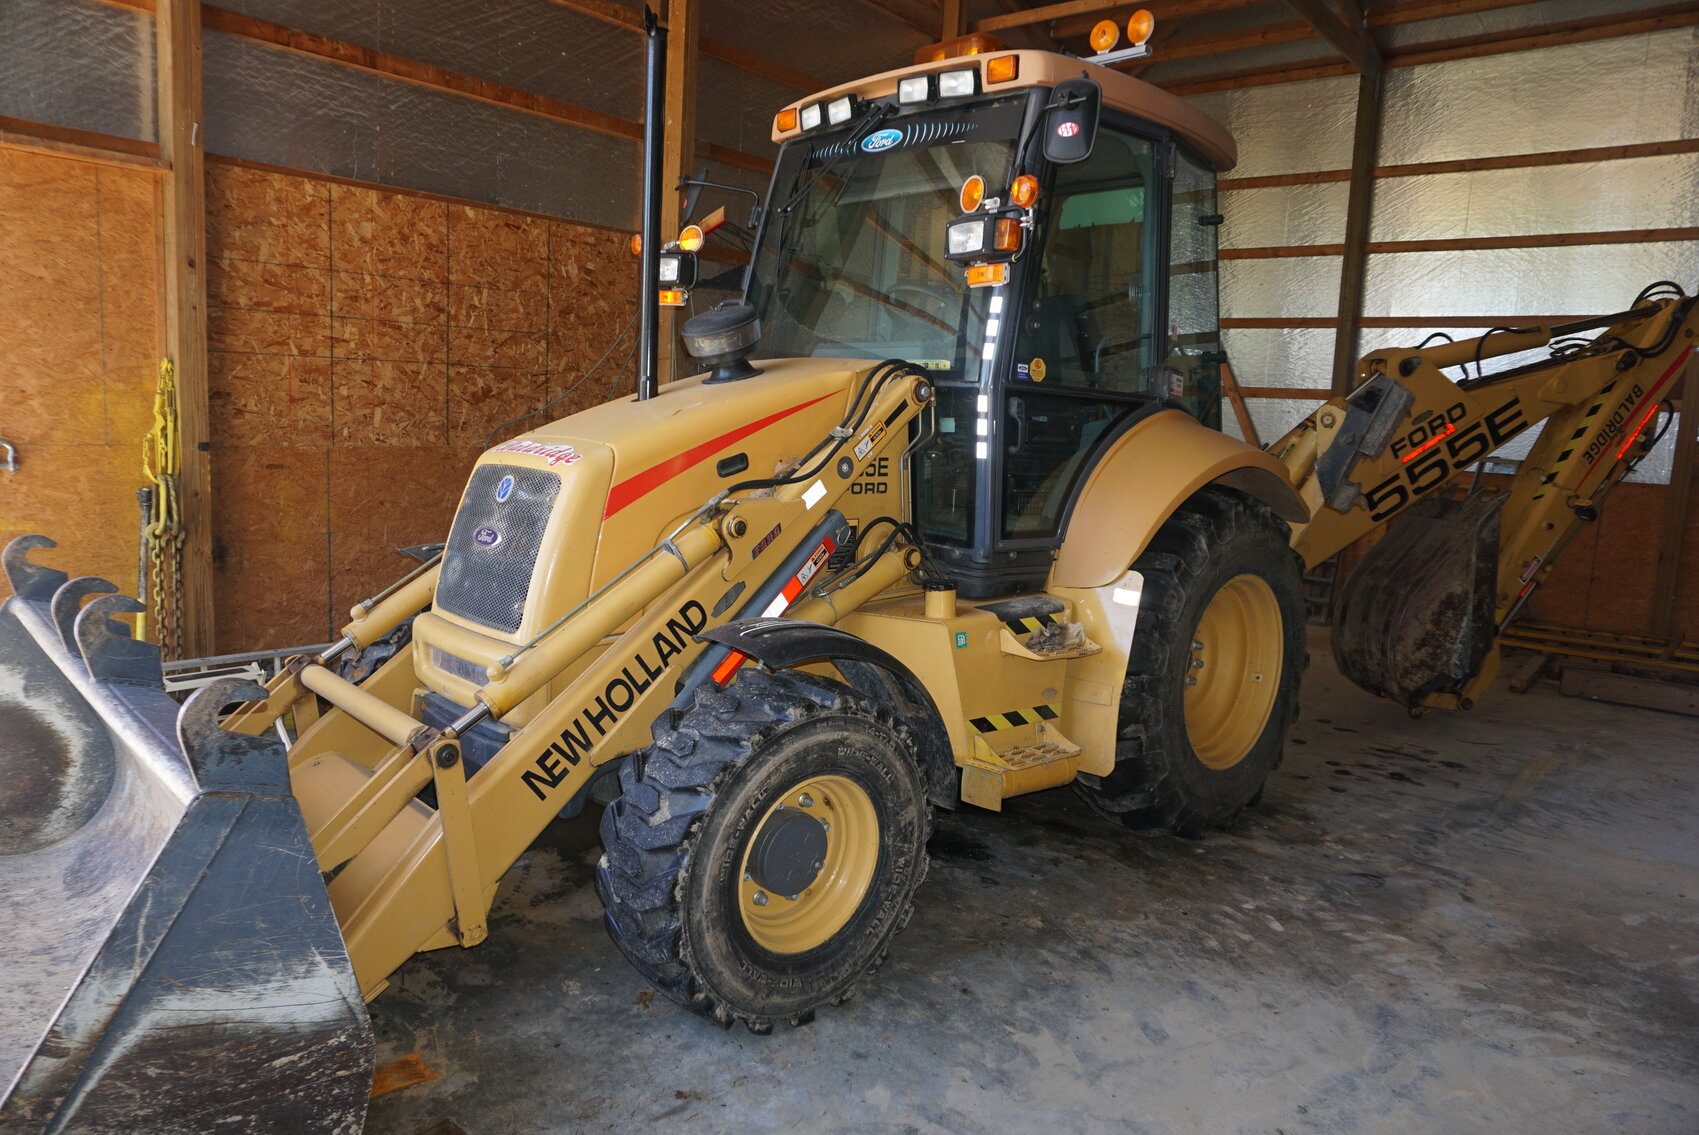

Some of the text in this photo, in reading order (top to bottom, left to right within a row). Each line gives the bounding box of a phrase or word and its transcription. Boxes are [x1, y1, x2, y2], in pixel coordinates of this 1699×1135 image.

[868, 133, 895, 149] Ford
[1391, 402, 1466, 459] FORD
[1583, 384, 1643, 465] BALDRIDGE
[848, 482, 888, 494] ORD
[1365, 397, 1529, 522] 555E
[521, 600, 707, 801] NEW HOLLAND
